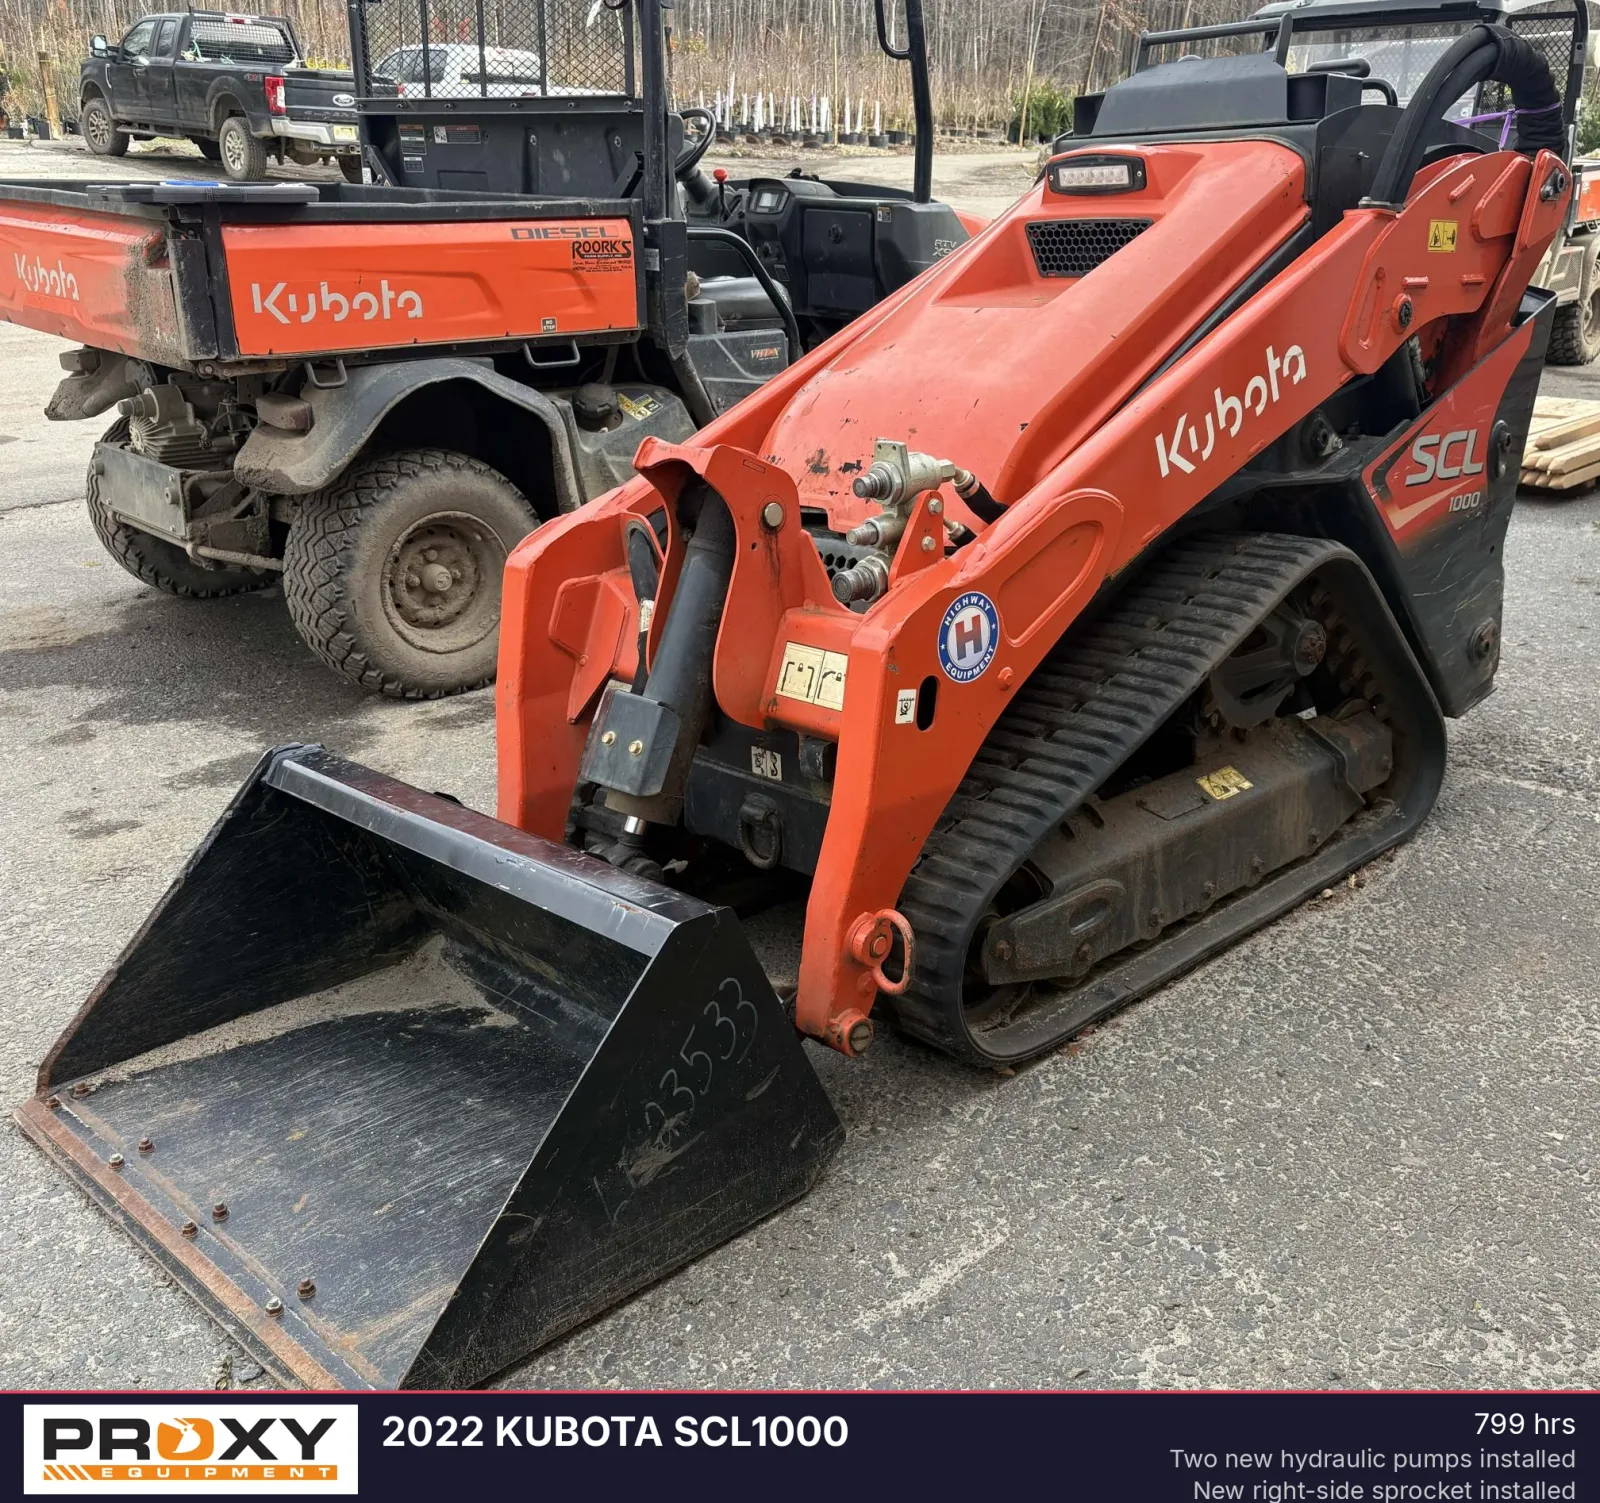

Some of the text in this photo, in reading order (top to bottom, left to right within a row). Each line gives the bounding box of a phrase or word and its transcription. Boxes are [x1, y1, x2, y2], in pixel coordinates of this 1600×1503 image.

[511, 226, 619, 240] DIESEL
[572, 240, 632, 259] ROORK'S
[934, 239, 957, 248] RTV
[14, 253, 80, 301] Kubota
[251, 279, 423, 324] Kubota
[1155, 345, 1307, 478] Kubota
[1405, 429, 1484, 487] SCL
[1448, 491, 1481, 512] 1000
[944, 595, 991, 627] HIGHWAY
[945, 645, 994, 679] EQUIPMENT
